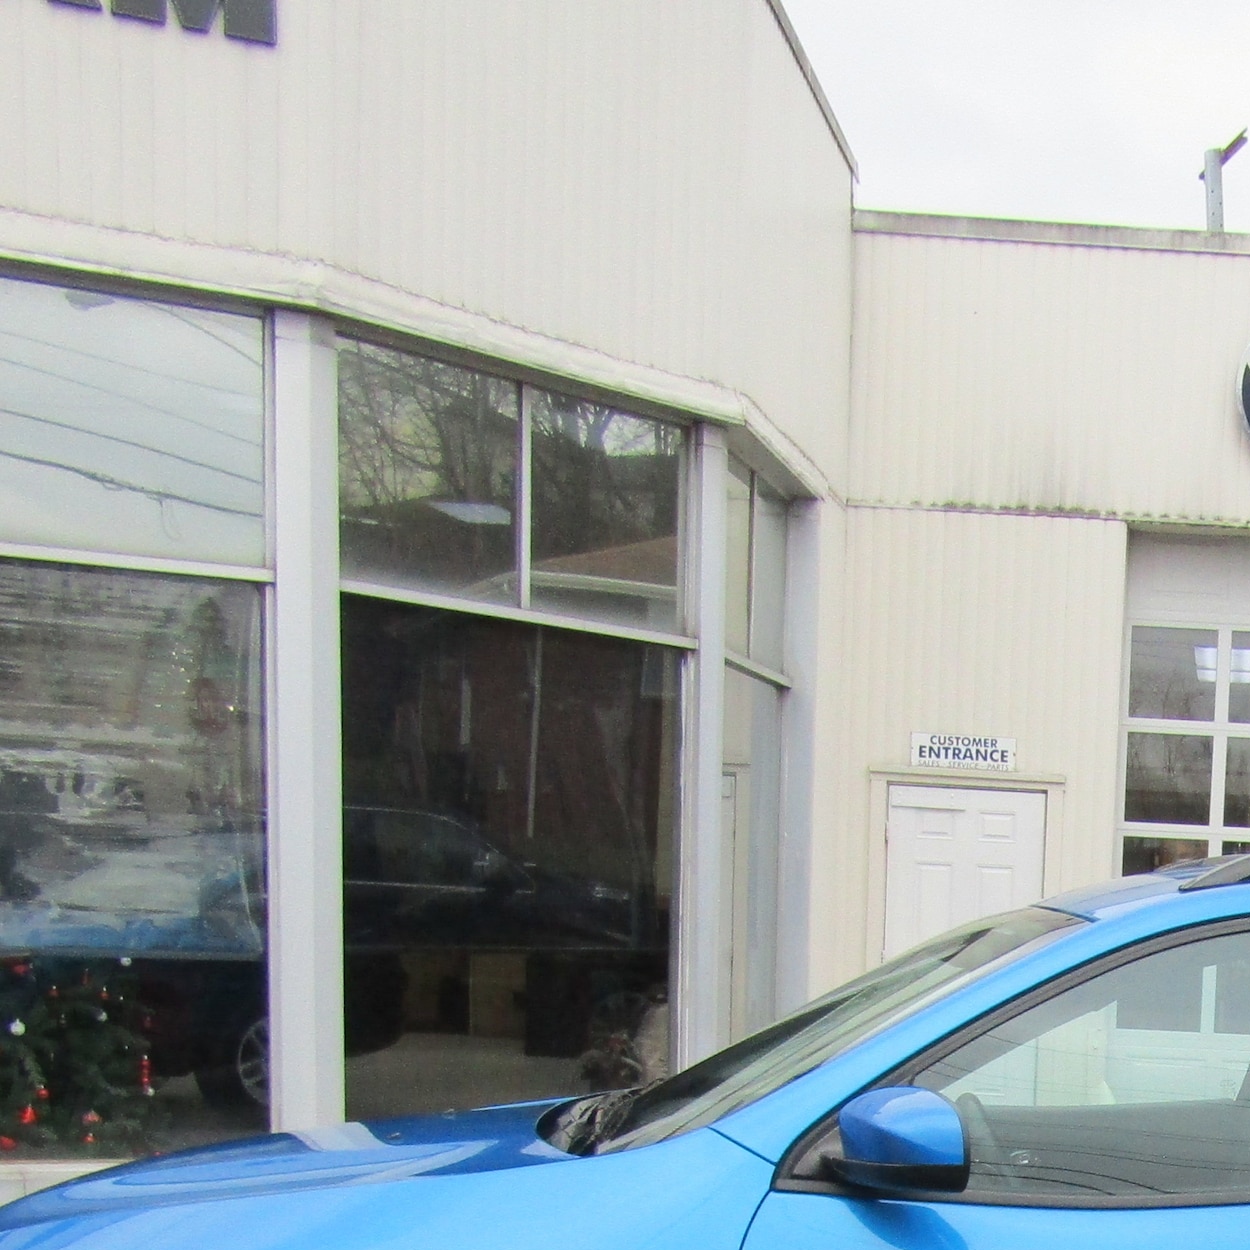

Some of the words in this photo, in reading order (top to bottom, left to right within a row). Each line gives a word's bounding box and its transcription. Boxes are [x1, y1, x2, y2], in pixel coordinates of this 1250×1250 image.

[930, 735, 998, 748] CUSTOMER
[918, 745, 1009, 763] ENTRANCE
[918, 760, 940, 768] SALES
[948, 761, 978, 770] SERVICE
[986, 763, 1009, 772] PARTS
